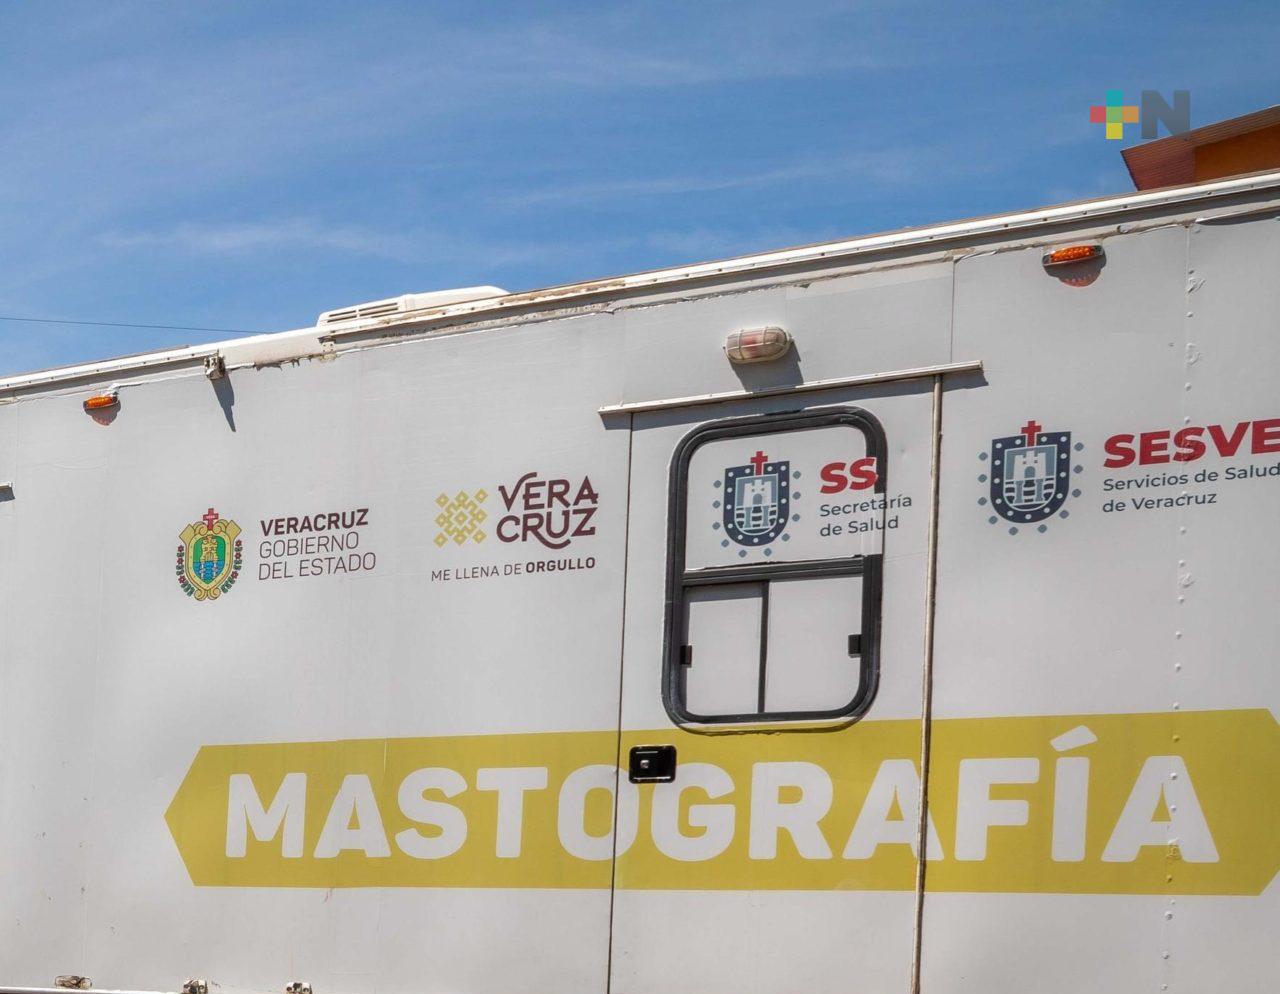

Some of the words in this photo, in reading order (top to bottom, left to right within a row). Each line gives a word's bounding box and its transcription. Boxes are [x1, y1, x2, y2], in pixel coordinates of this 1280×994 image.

[1103, 418, 1280, 469] SESVE
[820, 457, 878, 495] SS
[1103, 473, 1189, 492] Servicios
[1194, 469, 1219, 484] de
[1225, 462, 1280, 480] Salud
[498, 472, 599, 512] VERA
[820, 494, 912, 517] Secretaría
[1102, 500, 1126, 513] de
[1131, 493, 1217, 511] Veracruz
[260, 508, 369, 537] VERACRUZ
[496, 507, 598, 549] CRUZ
[820, 523, 842, 537] de
[848, 515, 899, 533] Salud
[260, 531, 359, 559] GOBIERNO
[258, 561, 294, 581] DEL
[299, 552, 376, 577] ESTADO
[431, 569, 451, 582] ME
[455, 565, 499, 580] LLENA
[504, 563, 522, 576] DE
[525, 557, 596, 574] ORGULLO
[225, 725, 1220, 864] MASTOGRAFÍA
